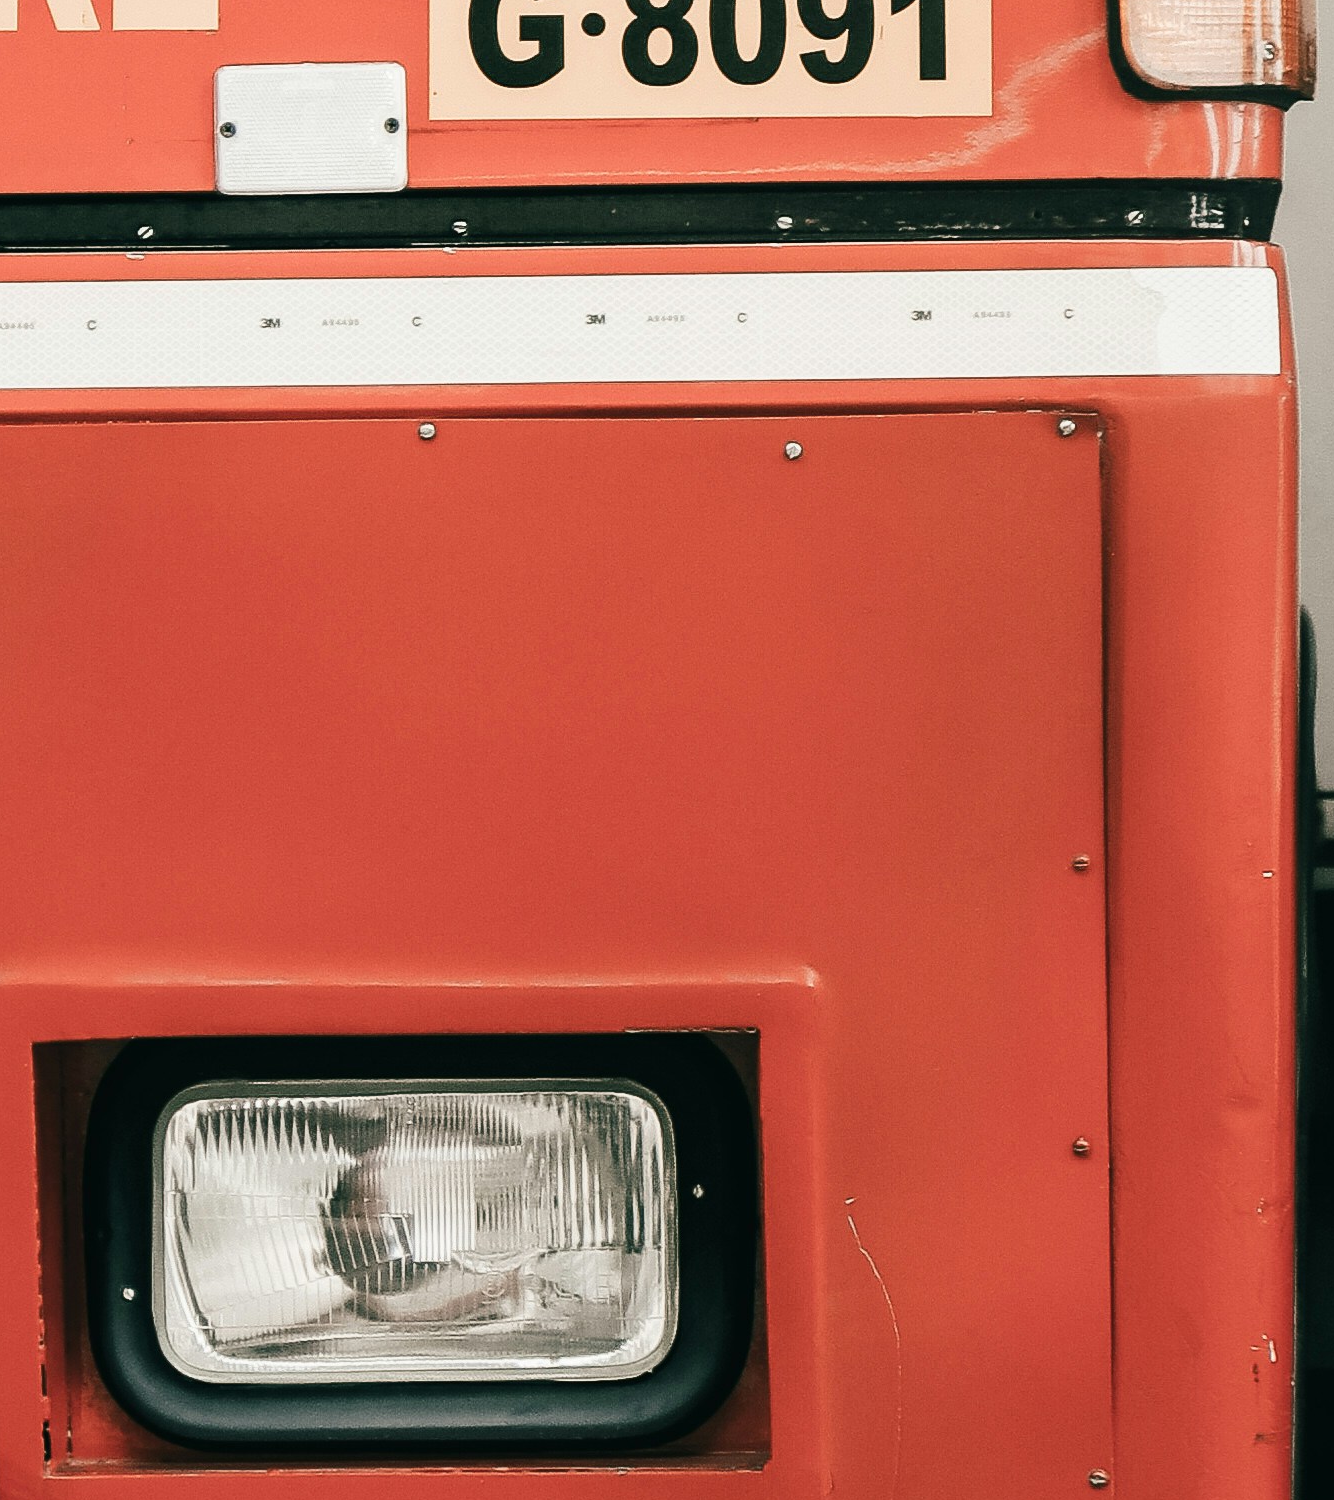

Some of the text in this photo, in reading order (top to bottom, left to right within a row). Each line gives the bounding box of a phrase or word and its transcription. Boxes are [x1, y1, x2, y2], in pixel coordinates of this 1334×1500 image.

[259, 317, 282, 329] 3M
[584, 312, 607, 325] 3M
[910, 309, 933, 322] 3M
